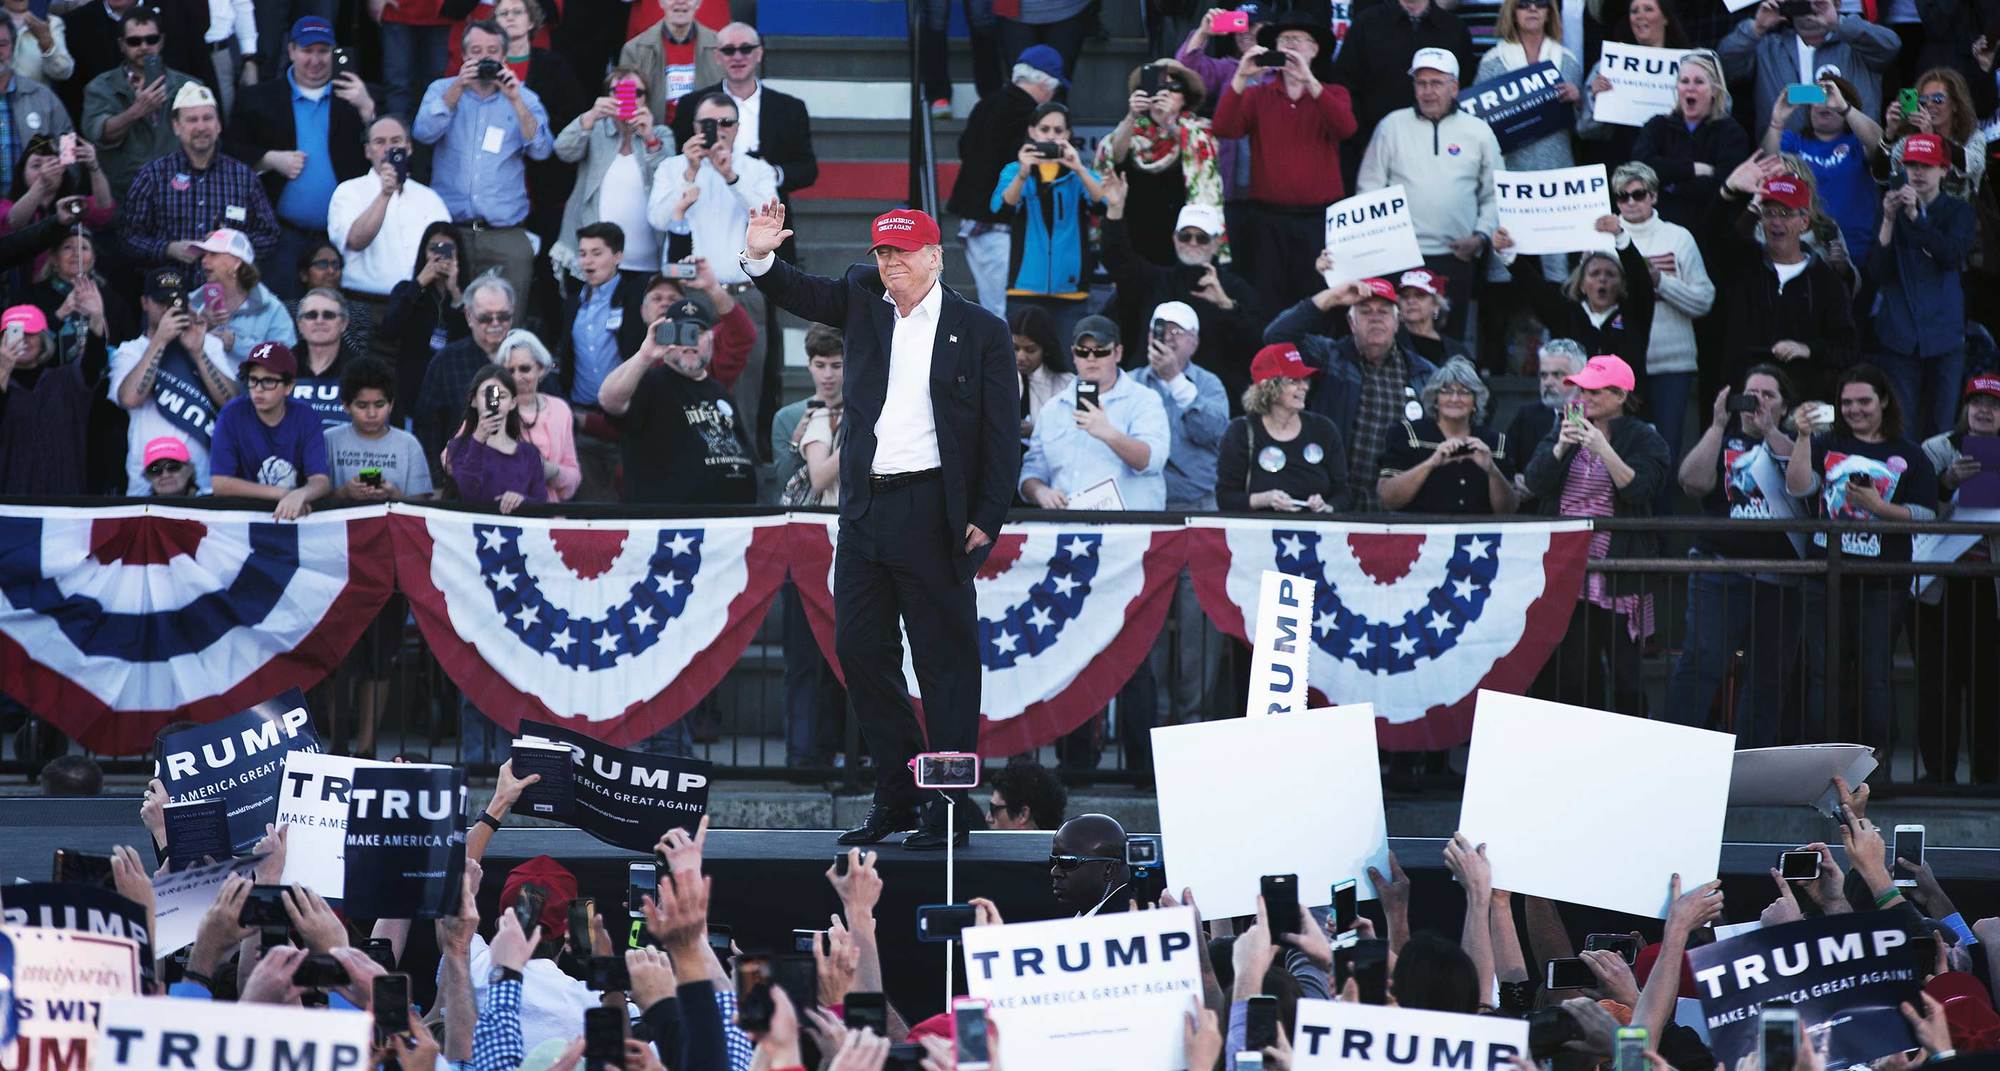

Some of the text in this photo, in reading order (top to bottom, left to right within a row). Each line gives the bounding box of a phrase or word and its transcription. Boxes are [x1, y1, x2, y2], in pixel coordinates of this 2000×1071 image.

[1460, 68, 1561, 115] TRUMP
[1497, 177, 1604, 199] TRUMP
[1327, 198, 1404, 232] TRUMP
[336, 458, 397, 469] MUSTACHE
[1268, 578, 1299, 715] RUMP
[154, 706, 308, 781] RUMP
[179, 777, 237, 805] AMERICA
[239, 760, 278, 785] GREAT
[556, 740, 707, 793] RUMP
[352, 789, 452, 820] TRU
[573, 773, 703, 813] ERICA GREAT AGAIN!
[280, 812, 315, 827] MAKE
[347, 834, 380, 846] MAKE
[383, 835, 442, 847] AMERICA
[2, 905, 148, 945] RUMP
[972, 931, 1191, 979] TRUMP
[1695, 929, 1907, 999] TRUMP
[1021, 991, 1086, 1007] AMERICA
[1092, 984, 1139, 1000] GREAT
[1708, 969, 1914, 1029] MAKE GREAT AGAIN!
[106, 1027, 359, 1071] TRUMP
[1302, 1024, 1520, 1071] TRUMP
